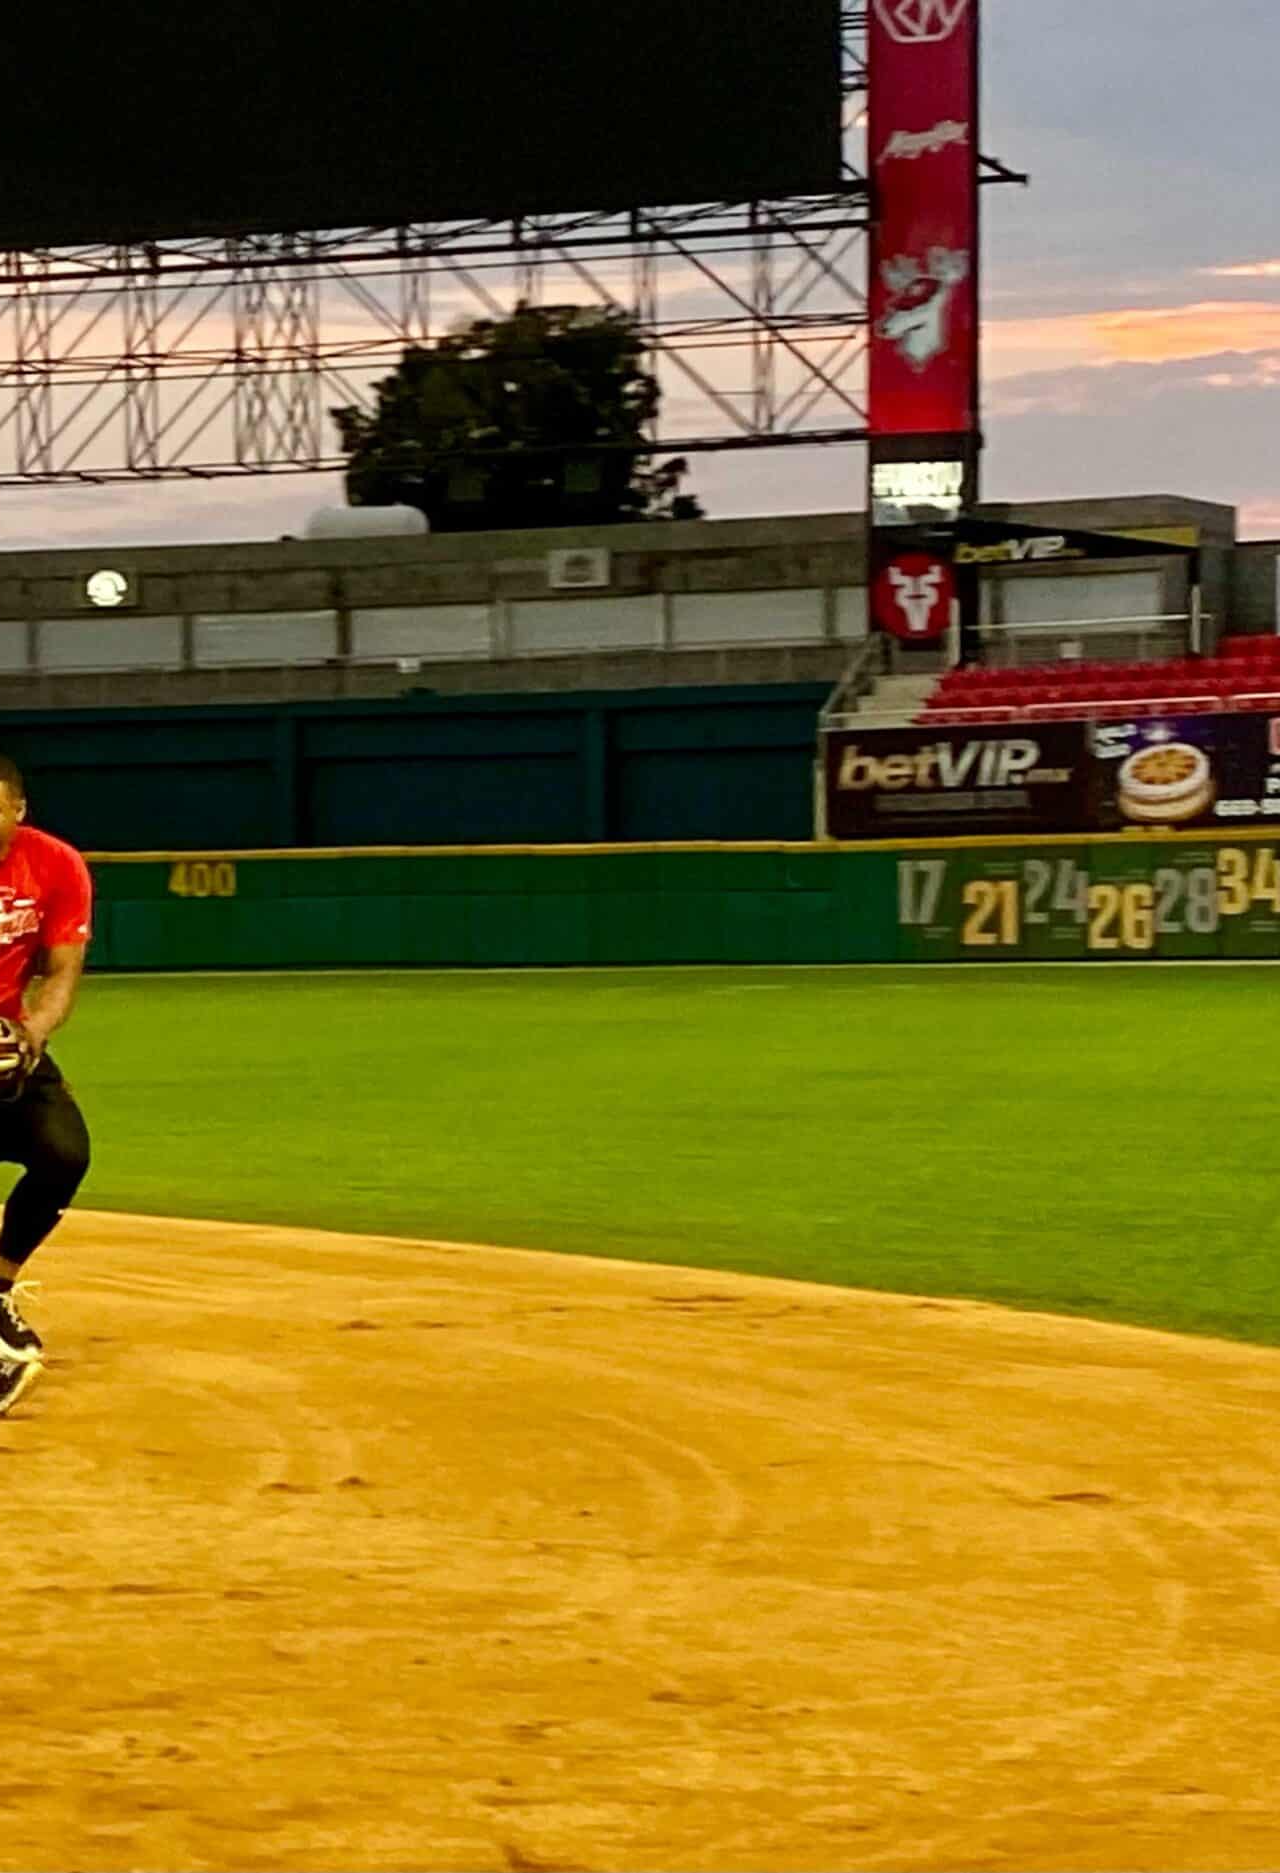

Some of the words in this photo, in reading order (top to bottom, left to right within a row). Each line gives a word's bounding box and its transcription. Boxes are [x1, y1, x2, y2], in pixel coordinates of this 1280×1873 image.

[168, 862, 236, 897] 400
[896, 859, 947, 924] 17
[961, 880, 1018, 945] 21
[1022, 858, 1089, 924] 24
[1153, 867, 1218, 933] 28
[1217, 848, 1280, 915] 34
[1087, 883, 1155, 949] 26
